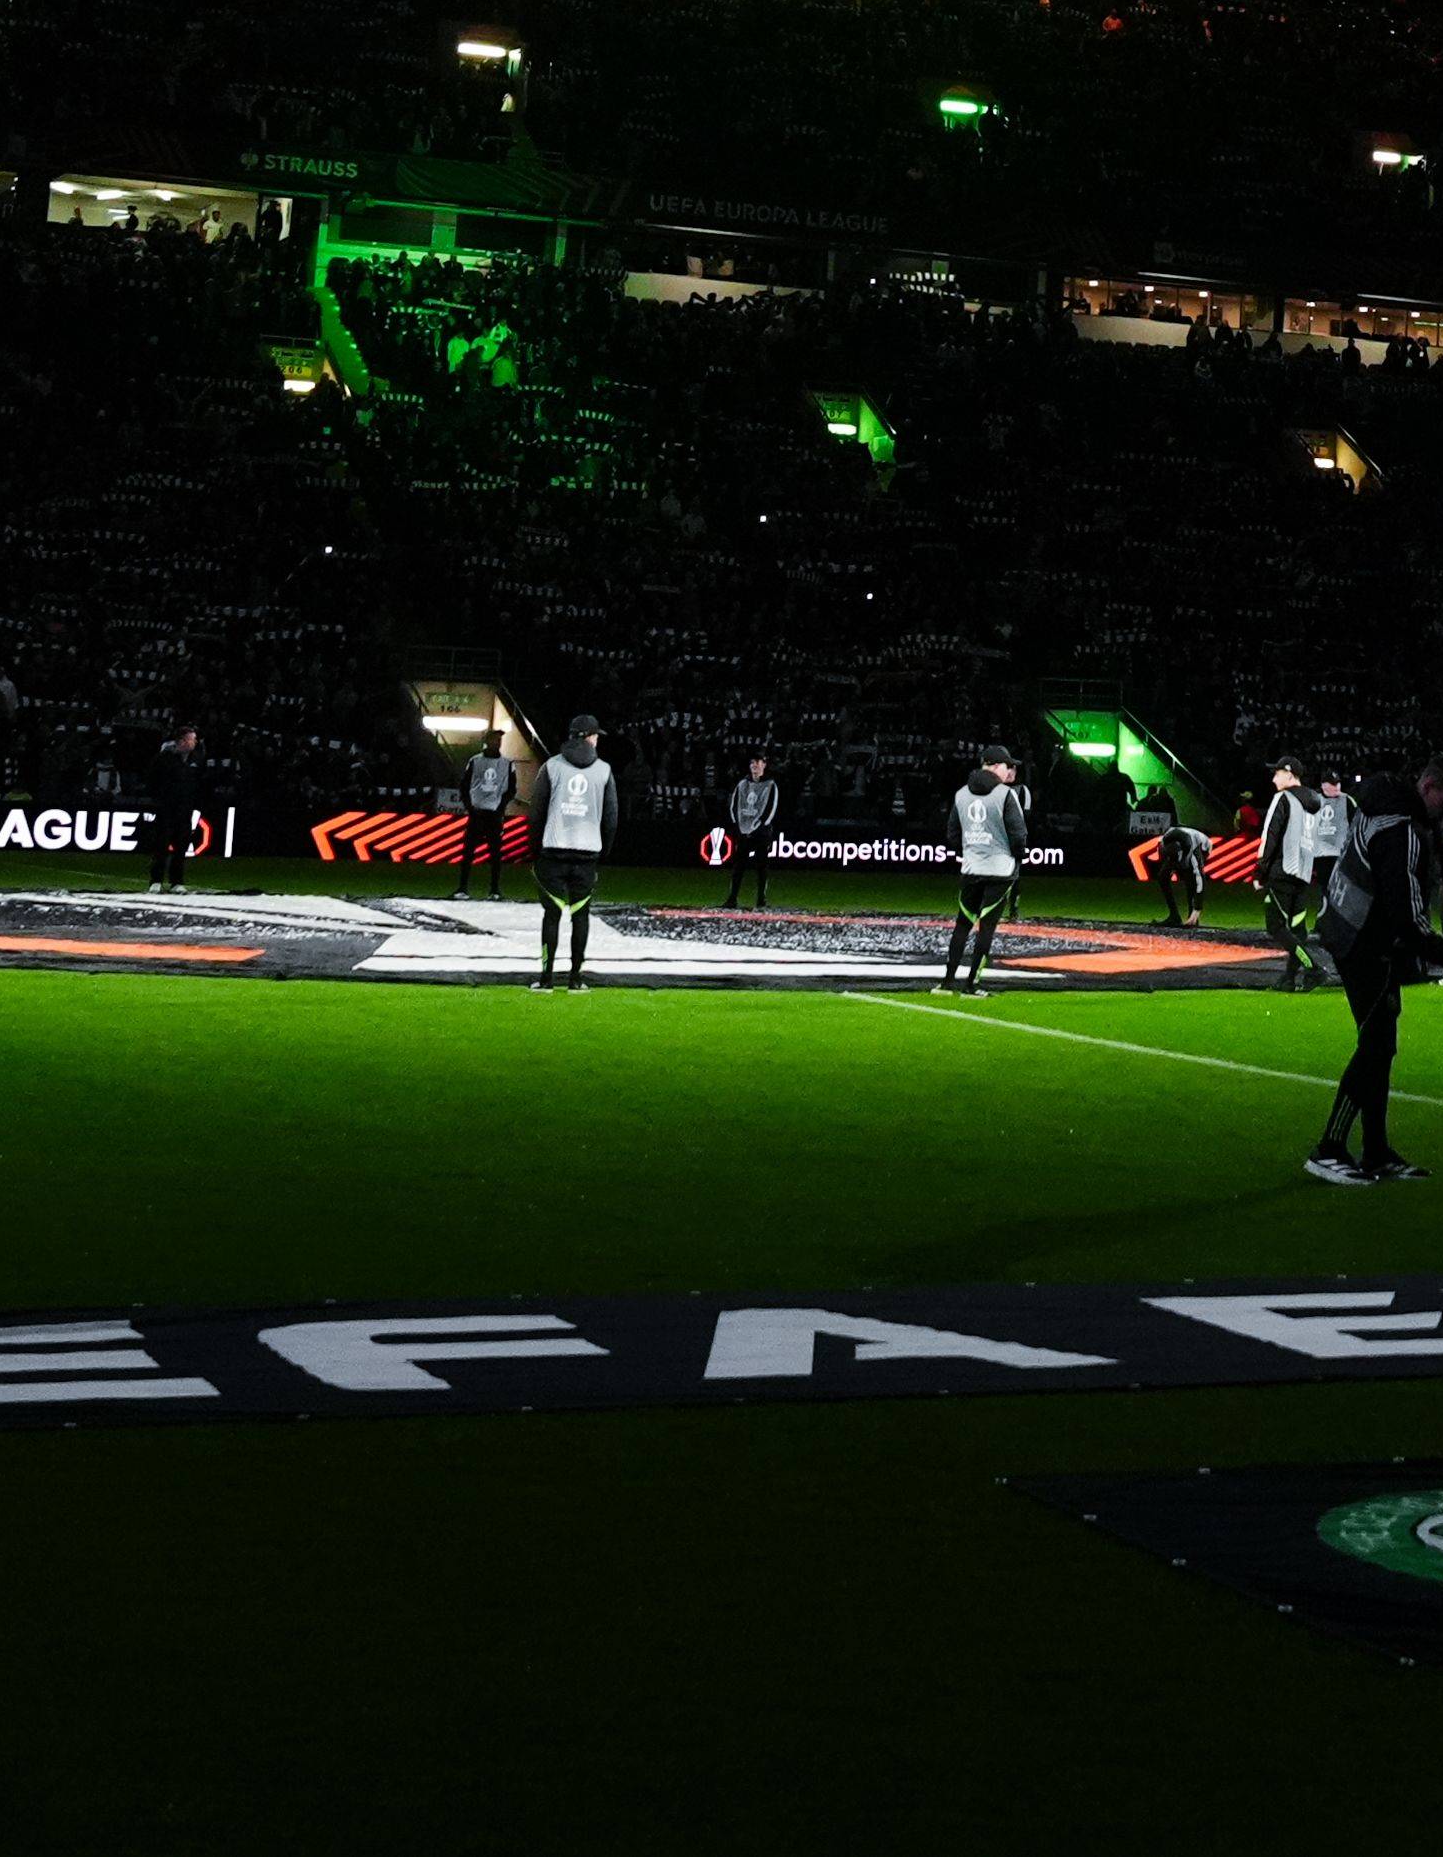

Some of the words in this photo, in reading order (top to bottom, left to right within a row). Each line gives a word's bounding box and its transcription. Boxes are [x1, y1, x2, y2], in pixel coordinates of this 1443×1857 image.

[649, 193, 708, 216] UEFA
[714, 200, 800, 226] EUROPA
[805, 209, 889, 235] LEAGUE
